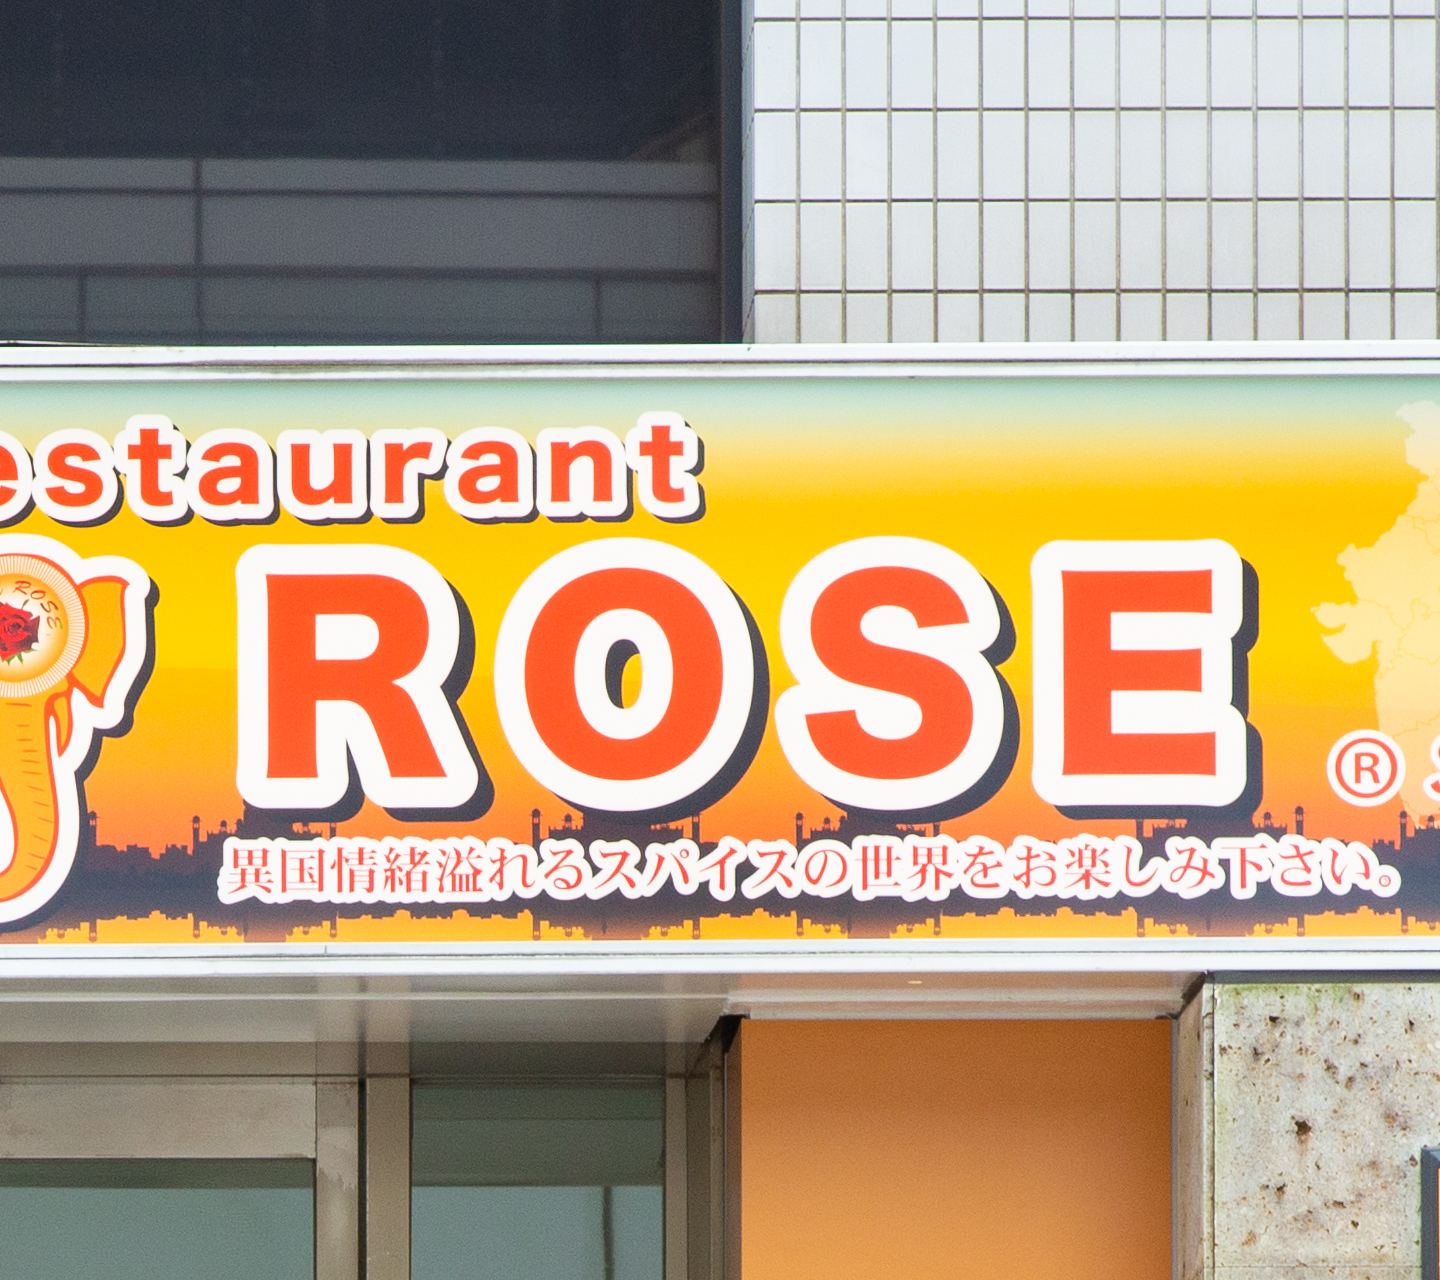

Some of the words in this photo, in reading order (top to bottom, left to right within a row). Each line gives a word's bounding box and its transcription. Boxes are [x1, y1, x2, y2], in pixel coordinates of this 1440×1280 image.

[250, 554, 1232, 796] ROSE
[222, 836, 1402, 902] 異国情緒溢れるスパイスの世界をお楽しみ下さい。
